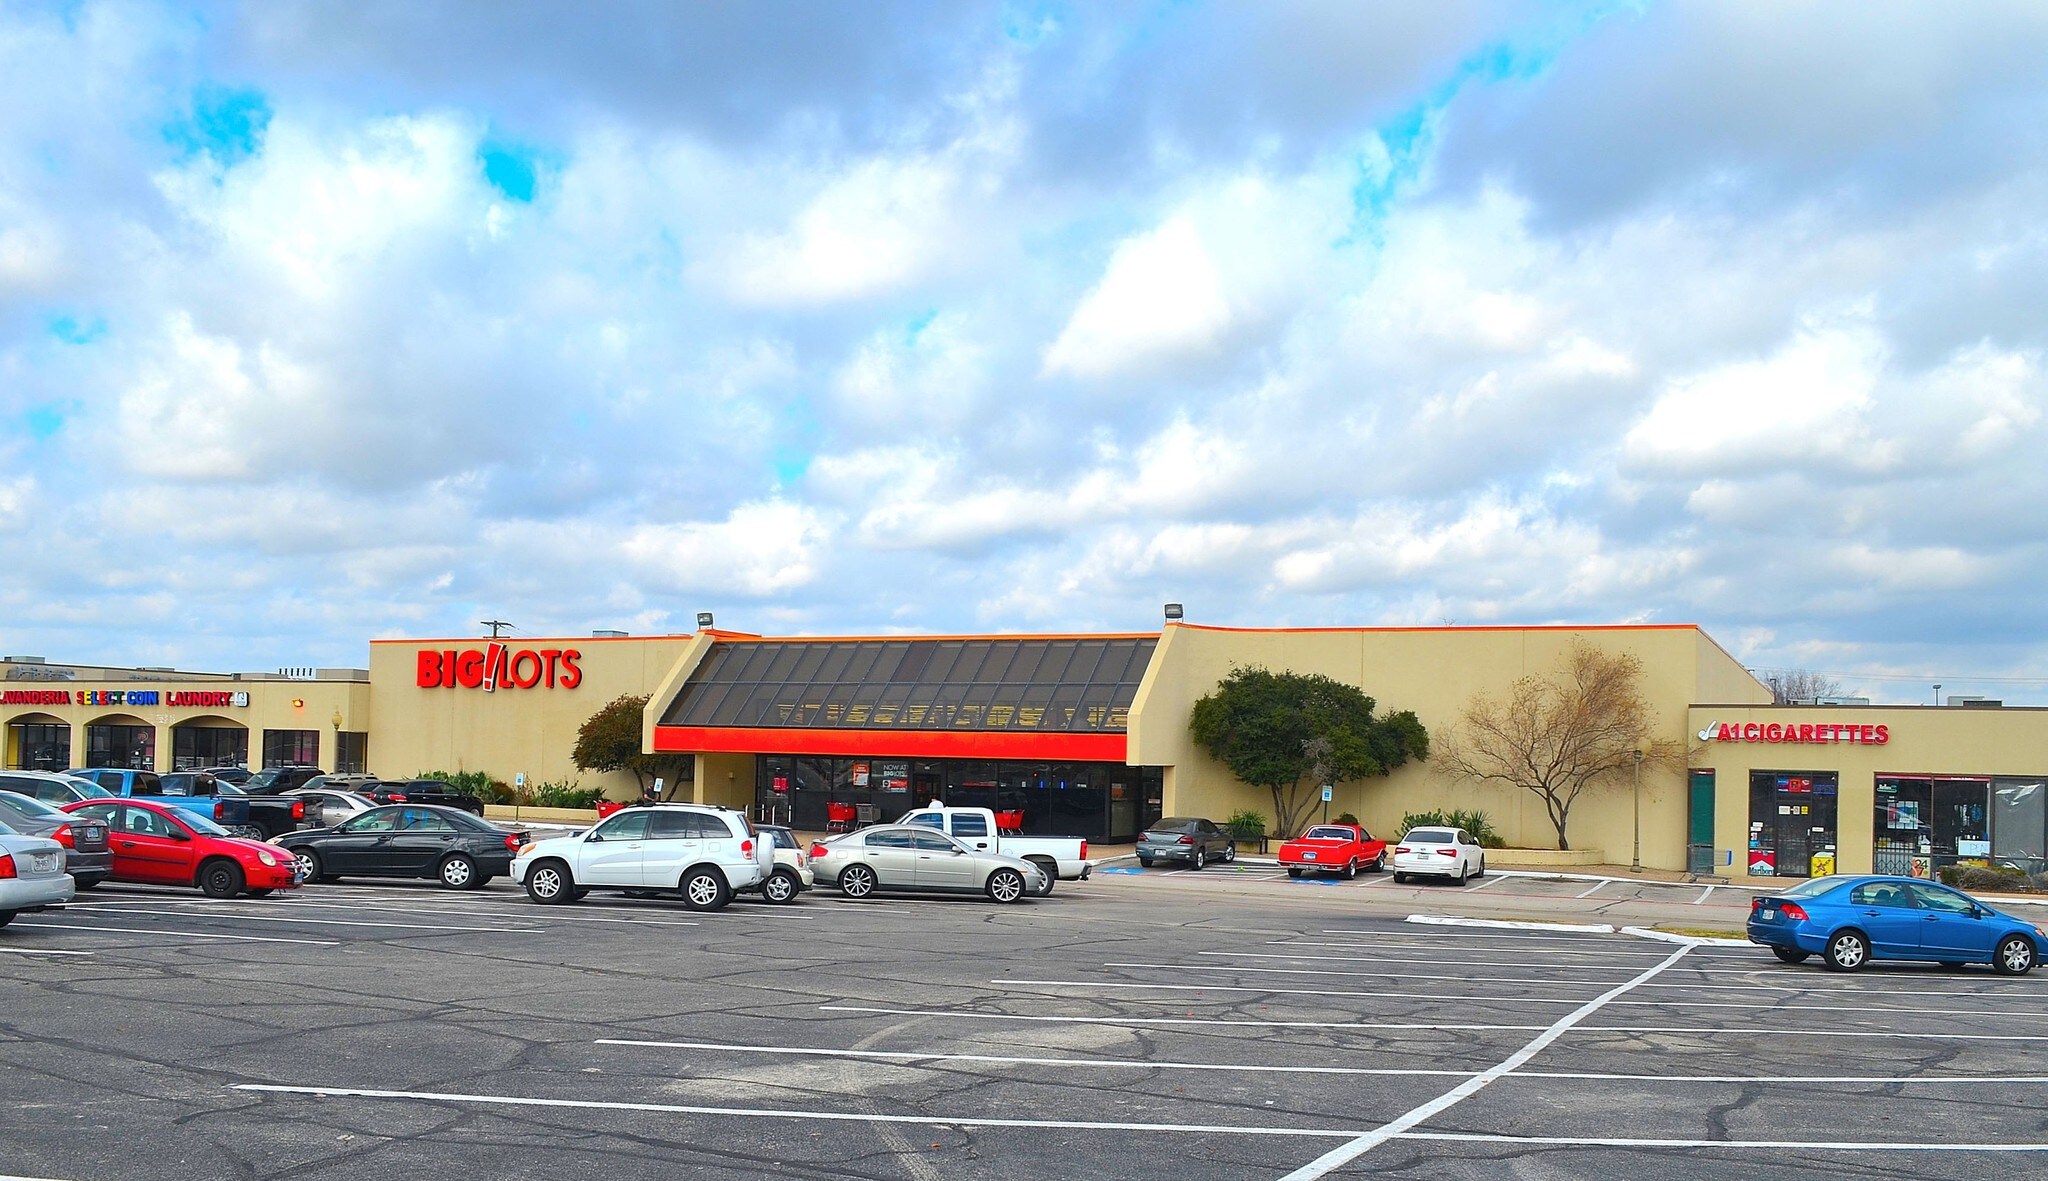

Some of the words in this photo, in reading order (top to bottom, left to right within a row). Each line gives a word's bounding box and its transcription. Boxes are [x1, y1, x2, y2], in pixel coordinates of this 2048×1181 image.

[498, 649, 582, 689] LOTS
[76, 690, 125, 706] SELECT
[126, 690, 159, 706] COIN
[165, 691, 233, 707] LAUNDRY
